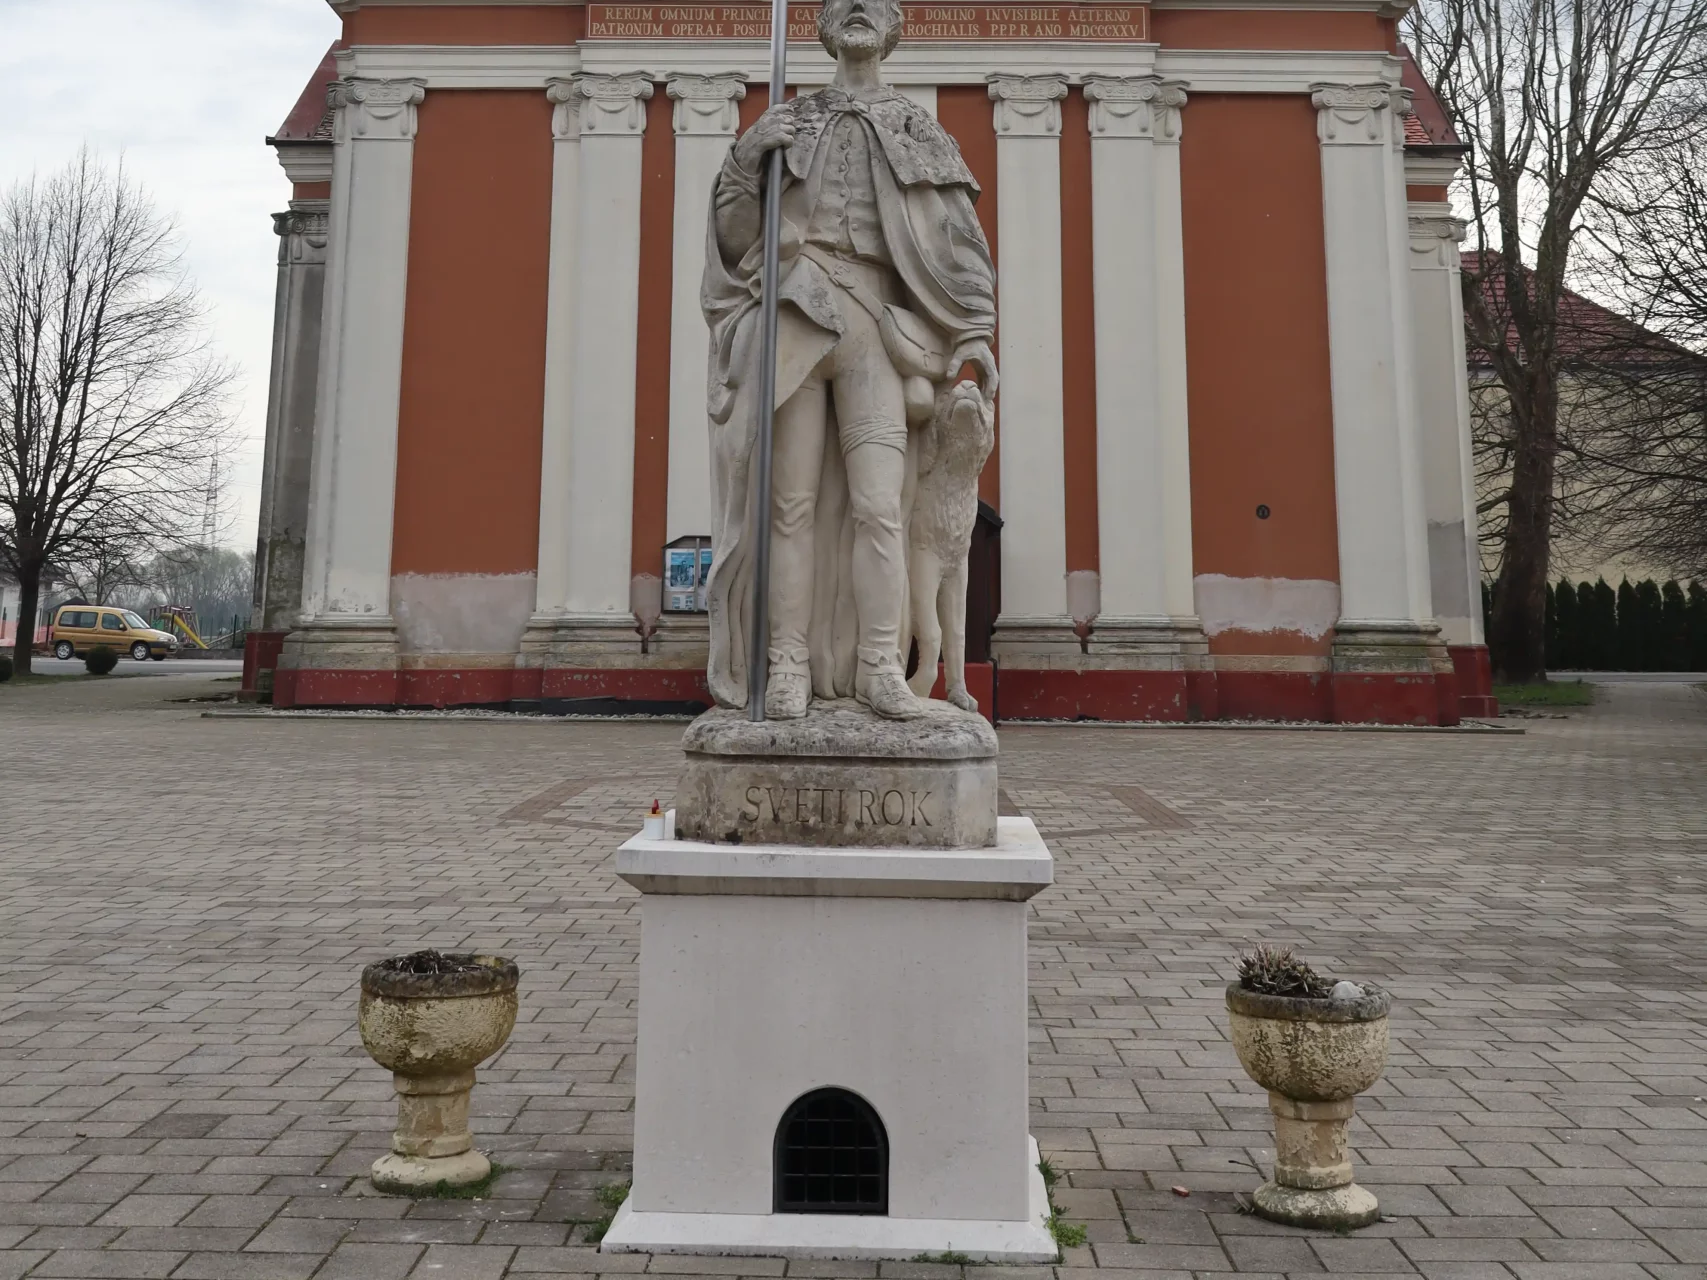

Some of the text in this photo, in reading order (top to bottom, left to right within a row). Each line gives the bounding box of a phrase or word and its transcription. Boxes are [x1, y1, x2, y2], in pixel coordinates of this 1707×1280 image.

[605, 7, 653, 20] RERUM
[660, 8, 716, 21] OMNIUM
[924, 8, 976, 21] DOMINO
[985, 8, 1060, 21] INVISIBILE
[1068, 9, 1131, 22] AETERNO
[592, 22, 663, 35] PATRONUM
[672, 23, 724, 36] OPERAE
[1035, 23, 1062, 36] ANO
[1069, 24, 1139, 37] MDCCCXXV
[744, 786, 932, 826] SVETI ROK
